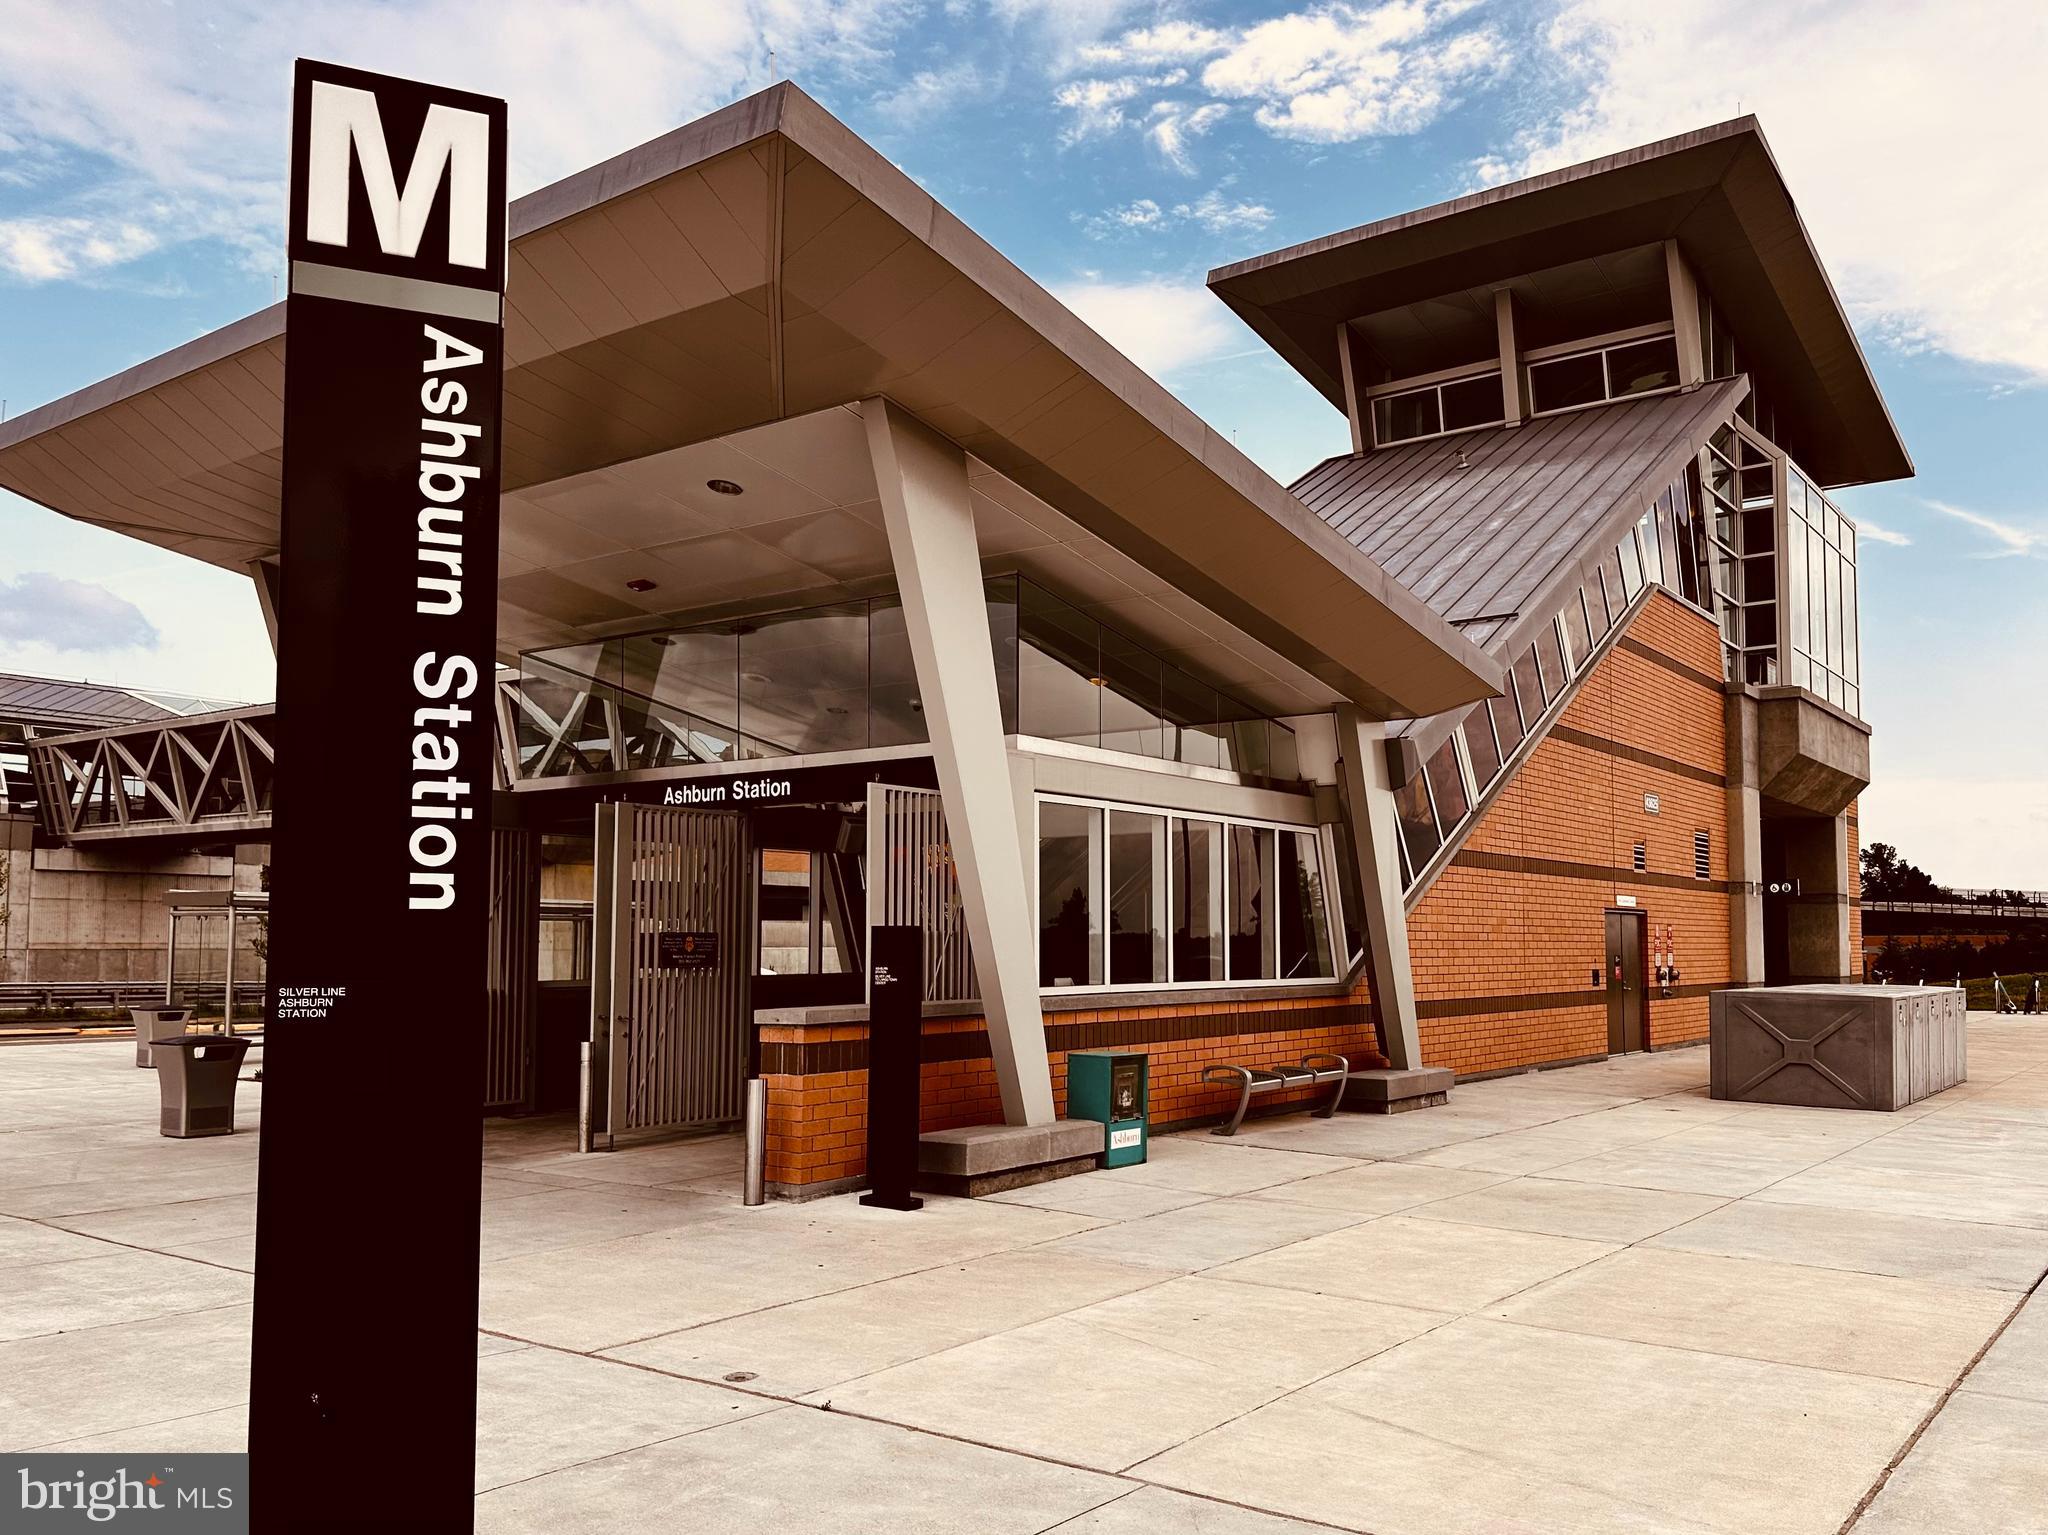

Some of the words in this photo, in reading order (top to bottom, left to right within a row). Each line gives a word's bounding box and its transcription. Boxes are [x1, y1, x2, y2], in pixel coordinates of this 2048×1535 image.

[307, 79, 490, 270] M
[416, 324, 485, 618] Ashburn
[408, 651, 478, 911] Station
[663, 784, 726, 805] Ashburn
[732, 778, 792, 800] Station
[278, 987, 319, 997] SILVER
[321, 987, 346, 997] LINE
[278, 997, 334, 1008] ASHBURN
[277, 1008, 327, 1019] STATION
